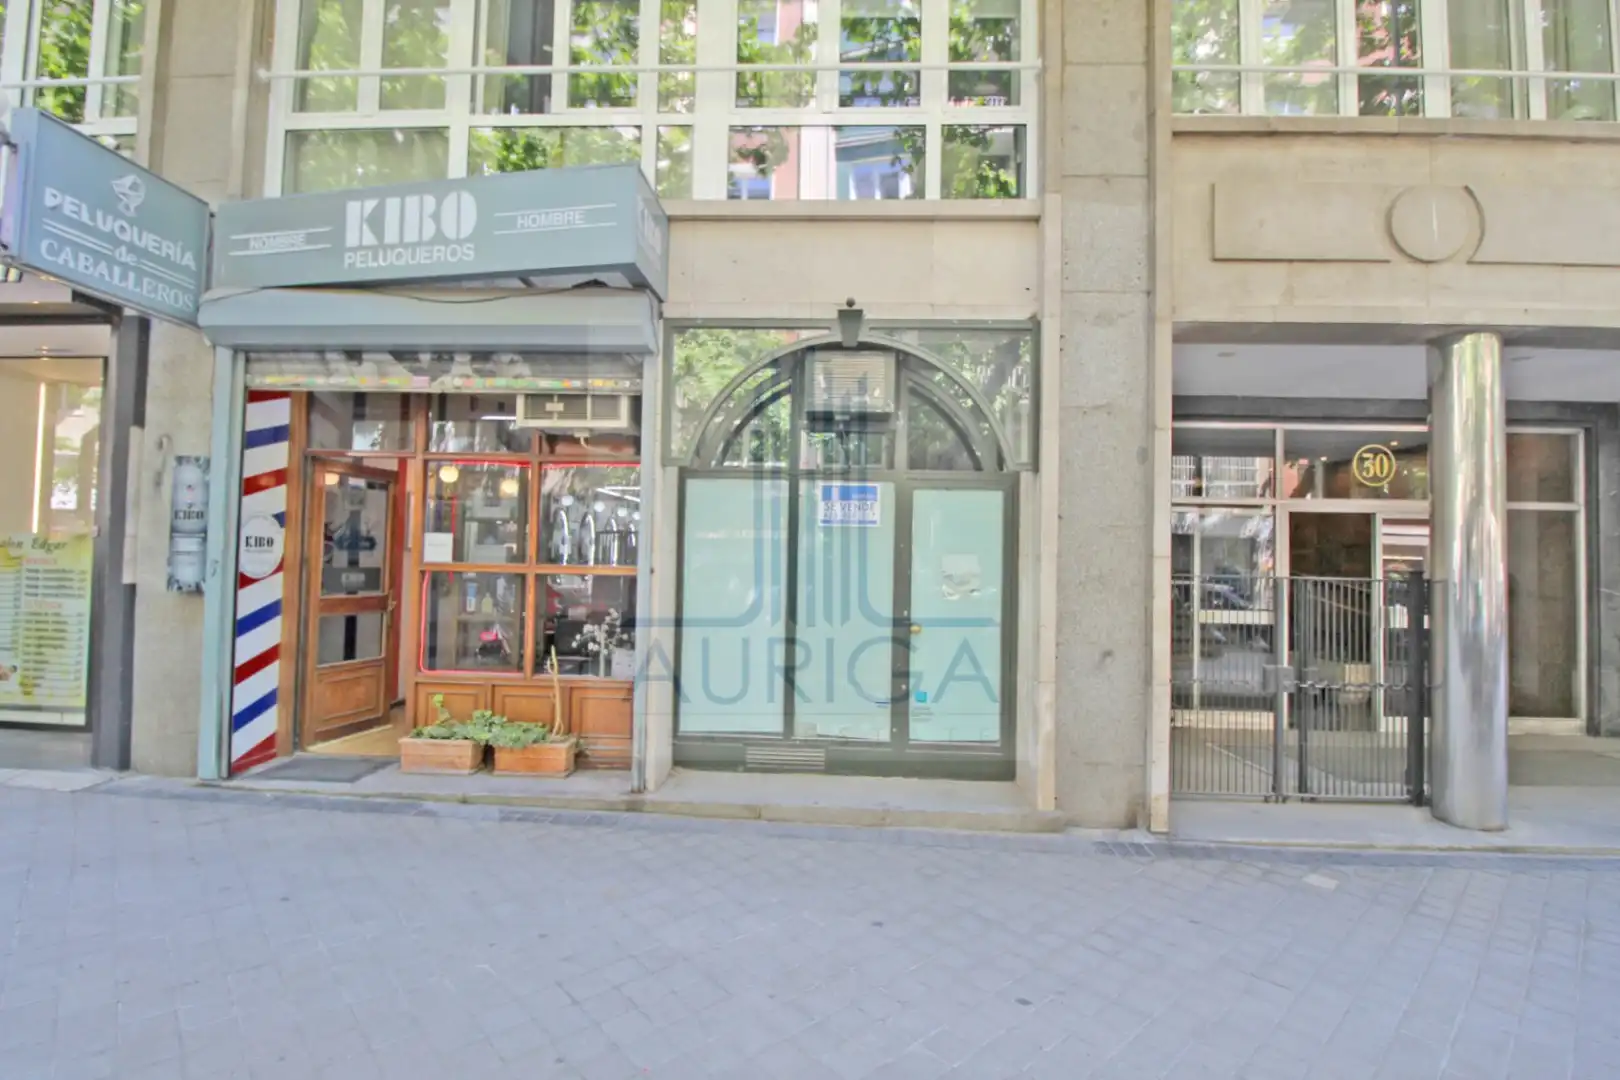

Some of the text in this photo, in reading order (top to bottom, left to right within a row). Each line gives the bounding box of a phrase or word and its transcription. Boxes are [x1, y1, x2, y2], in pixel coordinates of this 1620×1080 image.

[44, 187, 197, 270] PELUQUERÍA
[345, 190, 477, 248] KIBO
[517, 210, 586, 229] HOMBRE
[113, 245, 138, 266] de
[344, 243, 475, 269] PELUQUEROS
[40, 240, 194, 311] CABALLEROS
[174, 510, 204, 520] KIBO
[245, 536, 274, 547] KIBO
